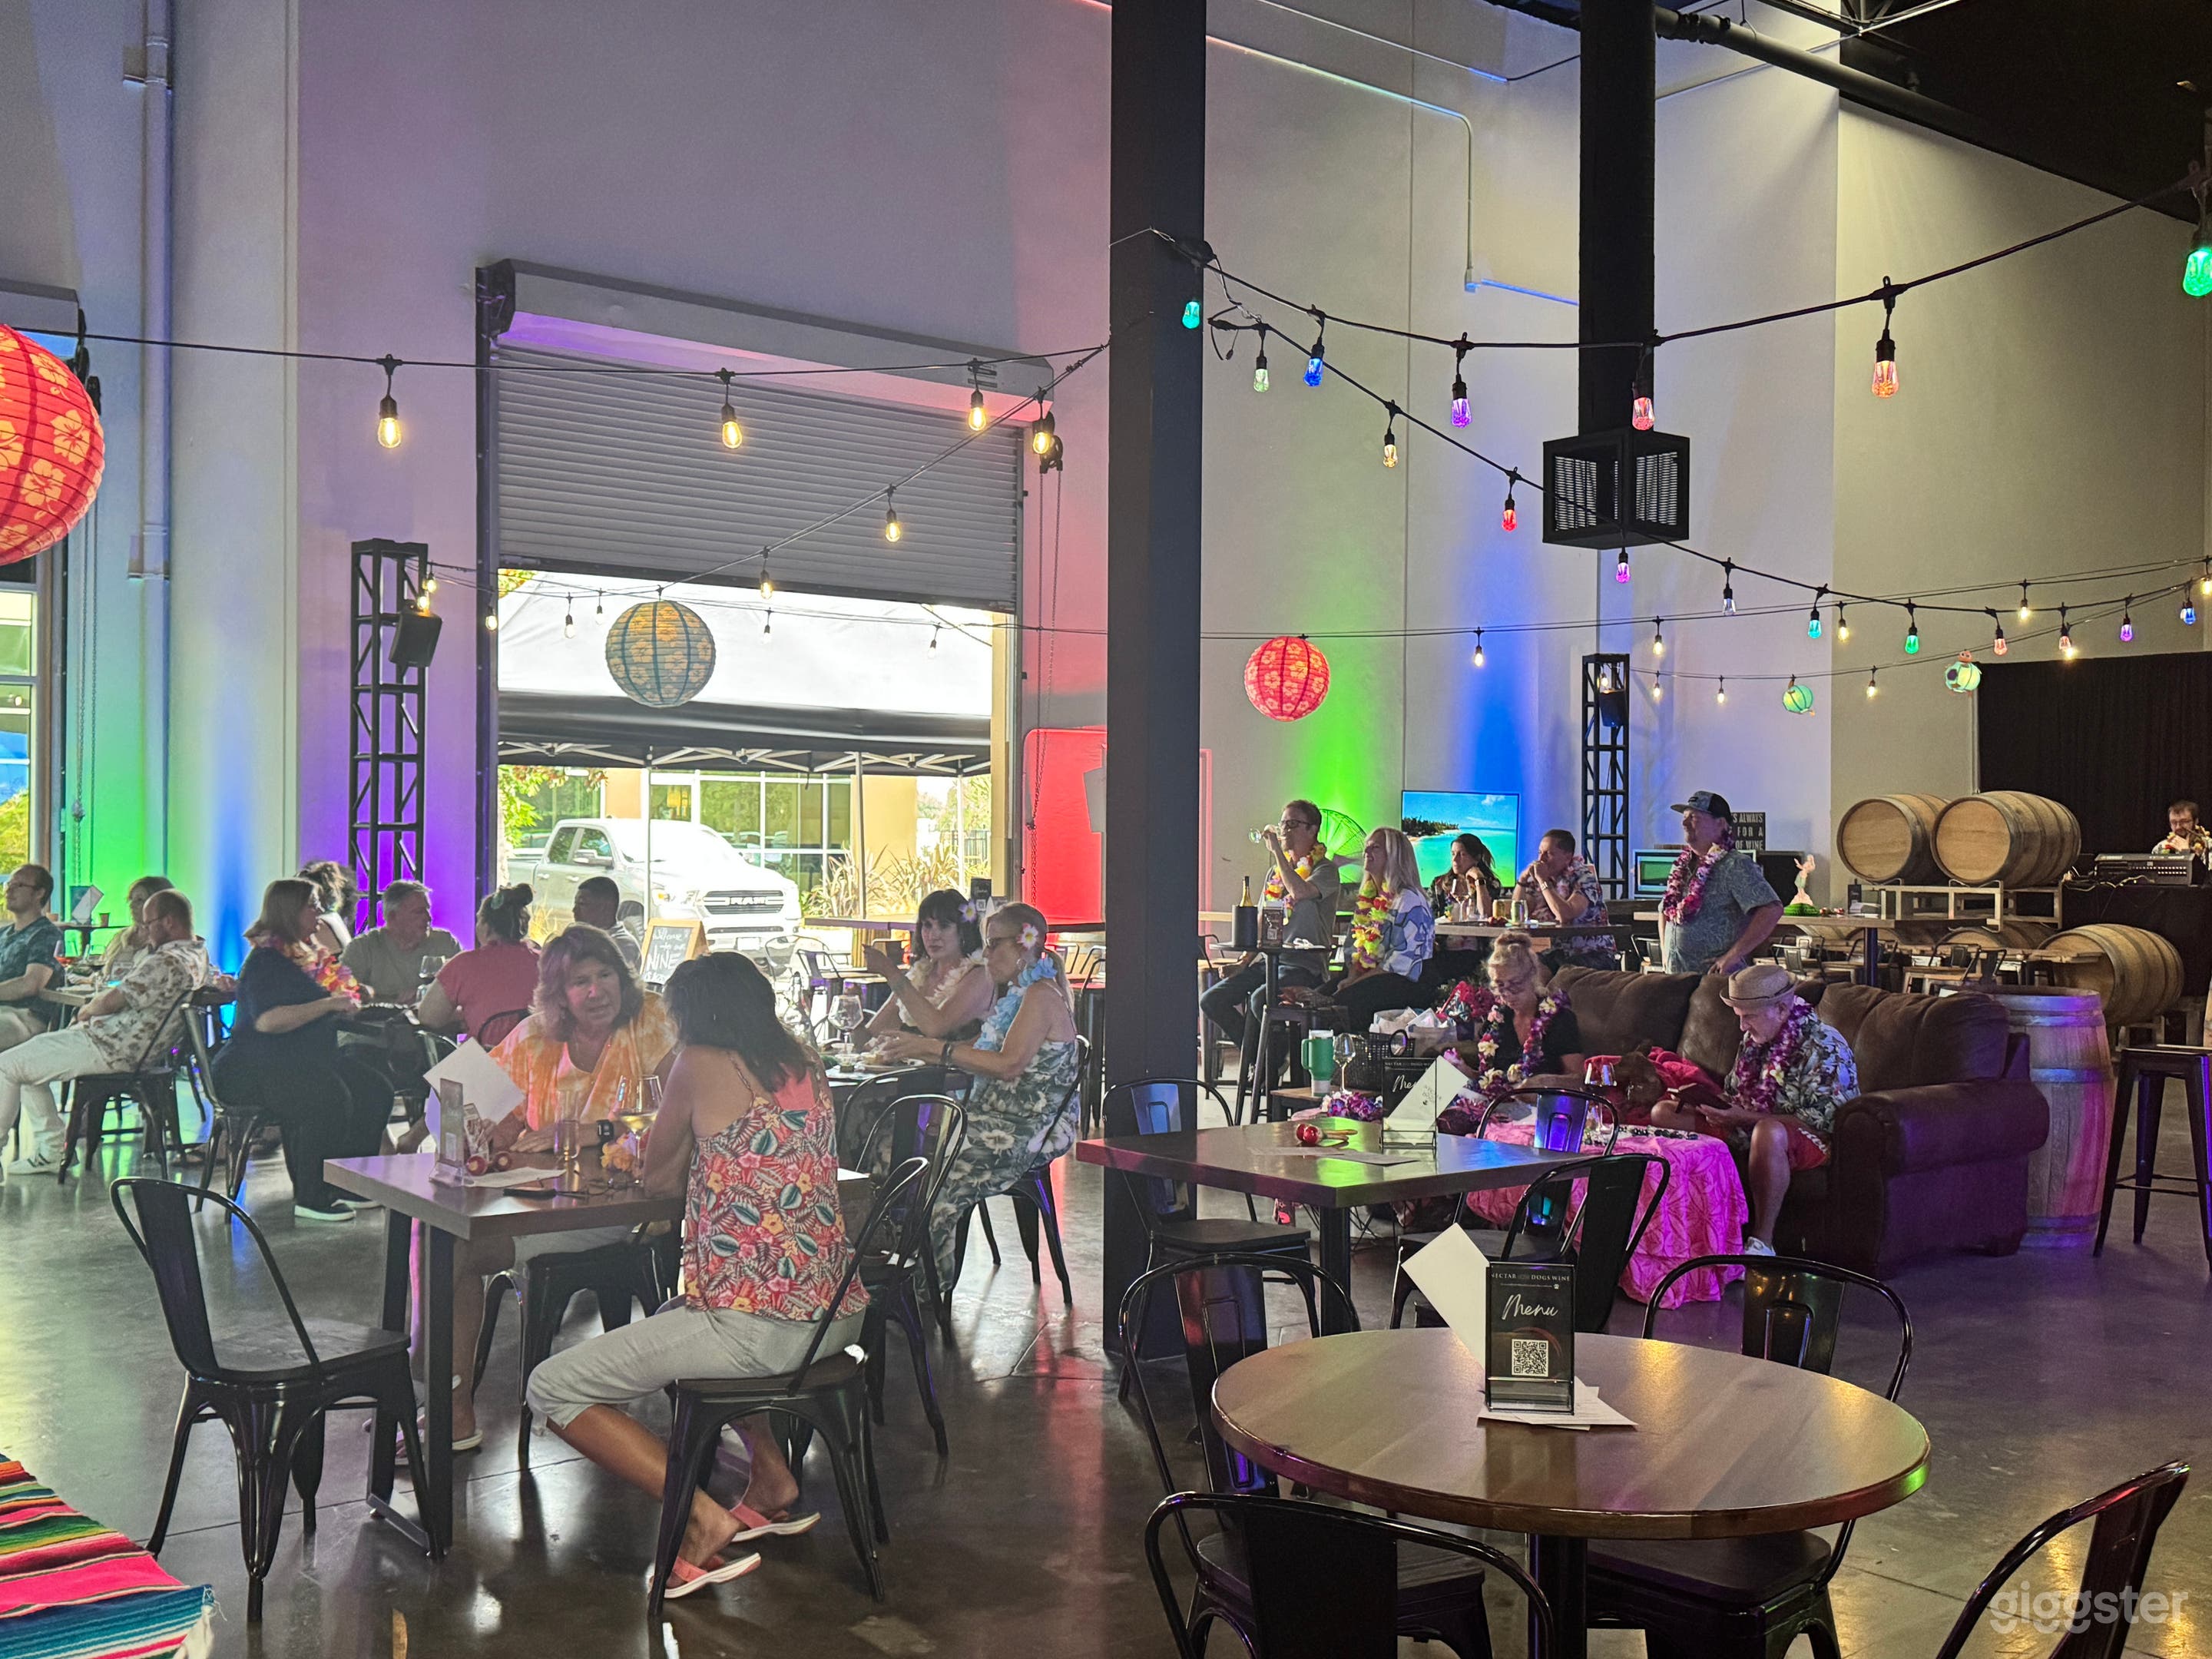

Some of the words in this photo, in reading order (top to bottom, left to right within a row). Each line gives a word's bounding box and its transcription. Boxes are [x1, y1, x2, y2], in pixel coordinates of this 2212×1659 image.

[1739, 813, 1763, 823] ALWAYS
[1737, 826, 1753, 837] FOR
[1758, 826, 1763, 837] A
[1735, 839, 1743, 849] OF
[1745, 839, 1763, 850] WINE
[730, 896, 765, 905] RAM
[1502, 1293, 1558, 1320] Menu
